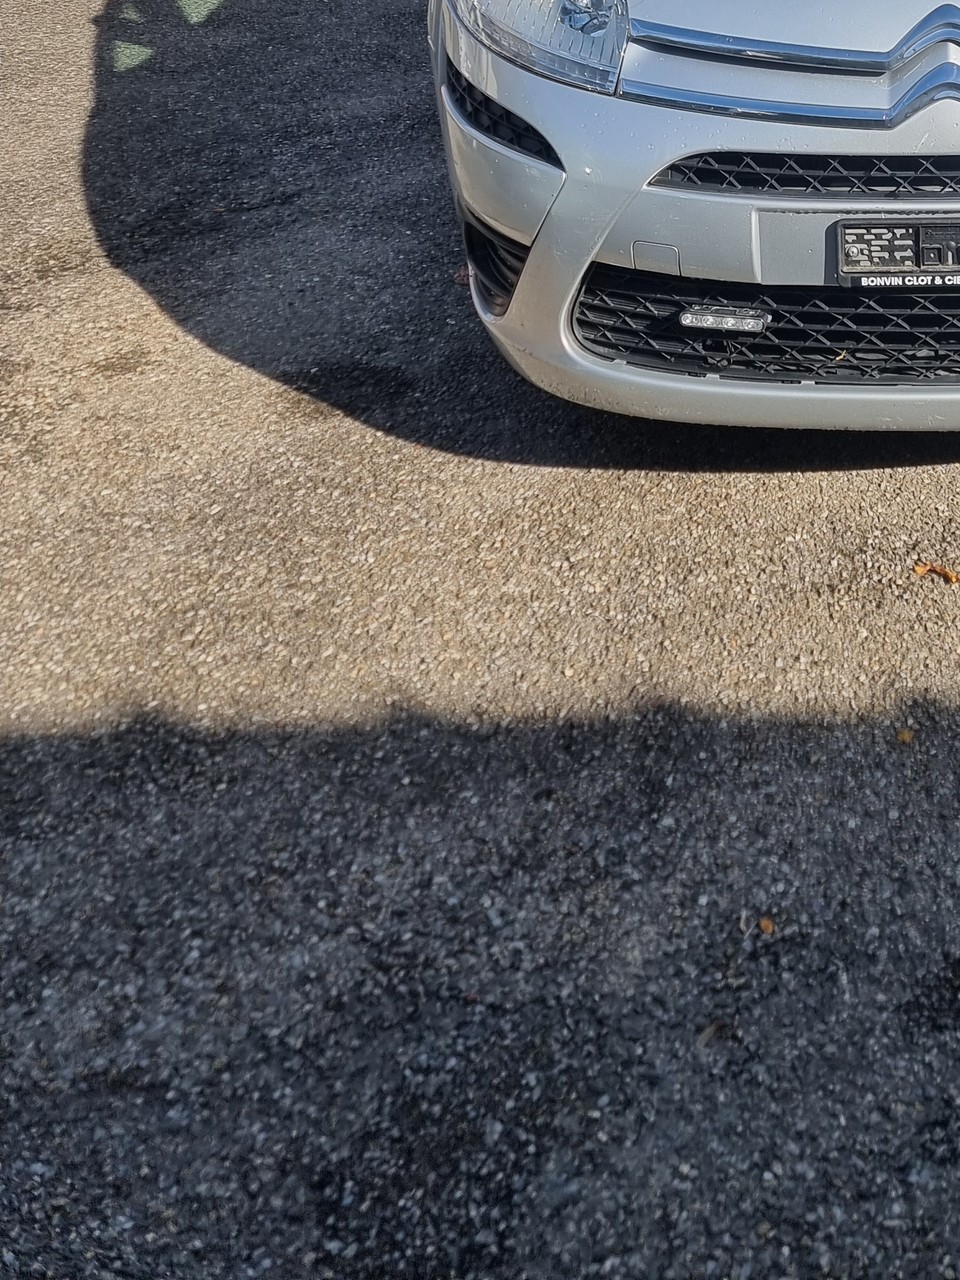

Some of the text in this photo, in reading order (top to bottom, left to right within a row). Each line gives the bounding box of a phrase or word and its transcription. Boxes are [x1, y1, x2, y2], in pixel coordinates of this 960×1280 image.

[861, 276, 903, 286] BONVIN
[904, 276, 933, 285] CLOT
[934, 276, 943, 285] &
